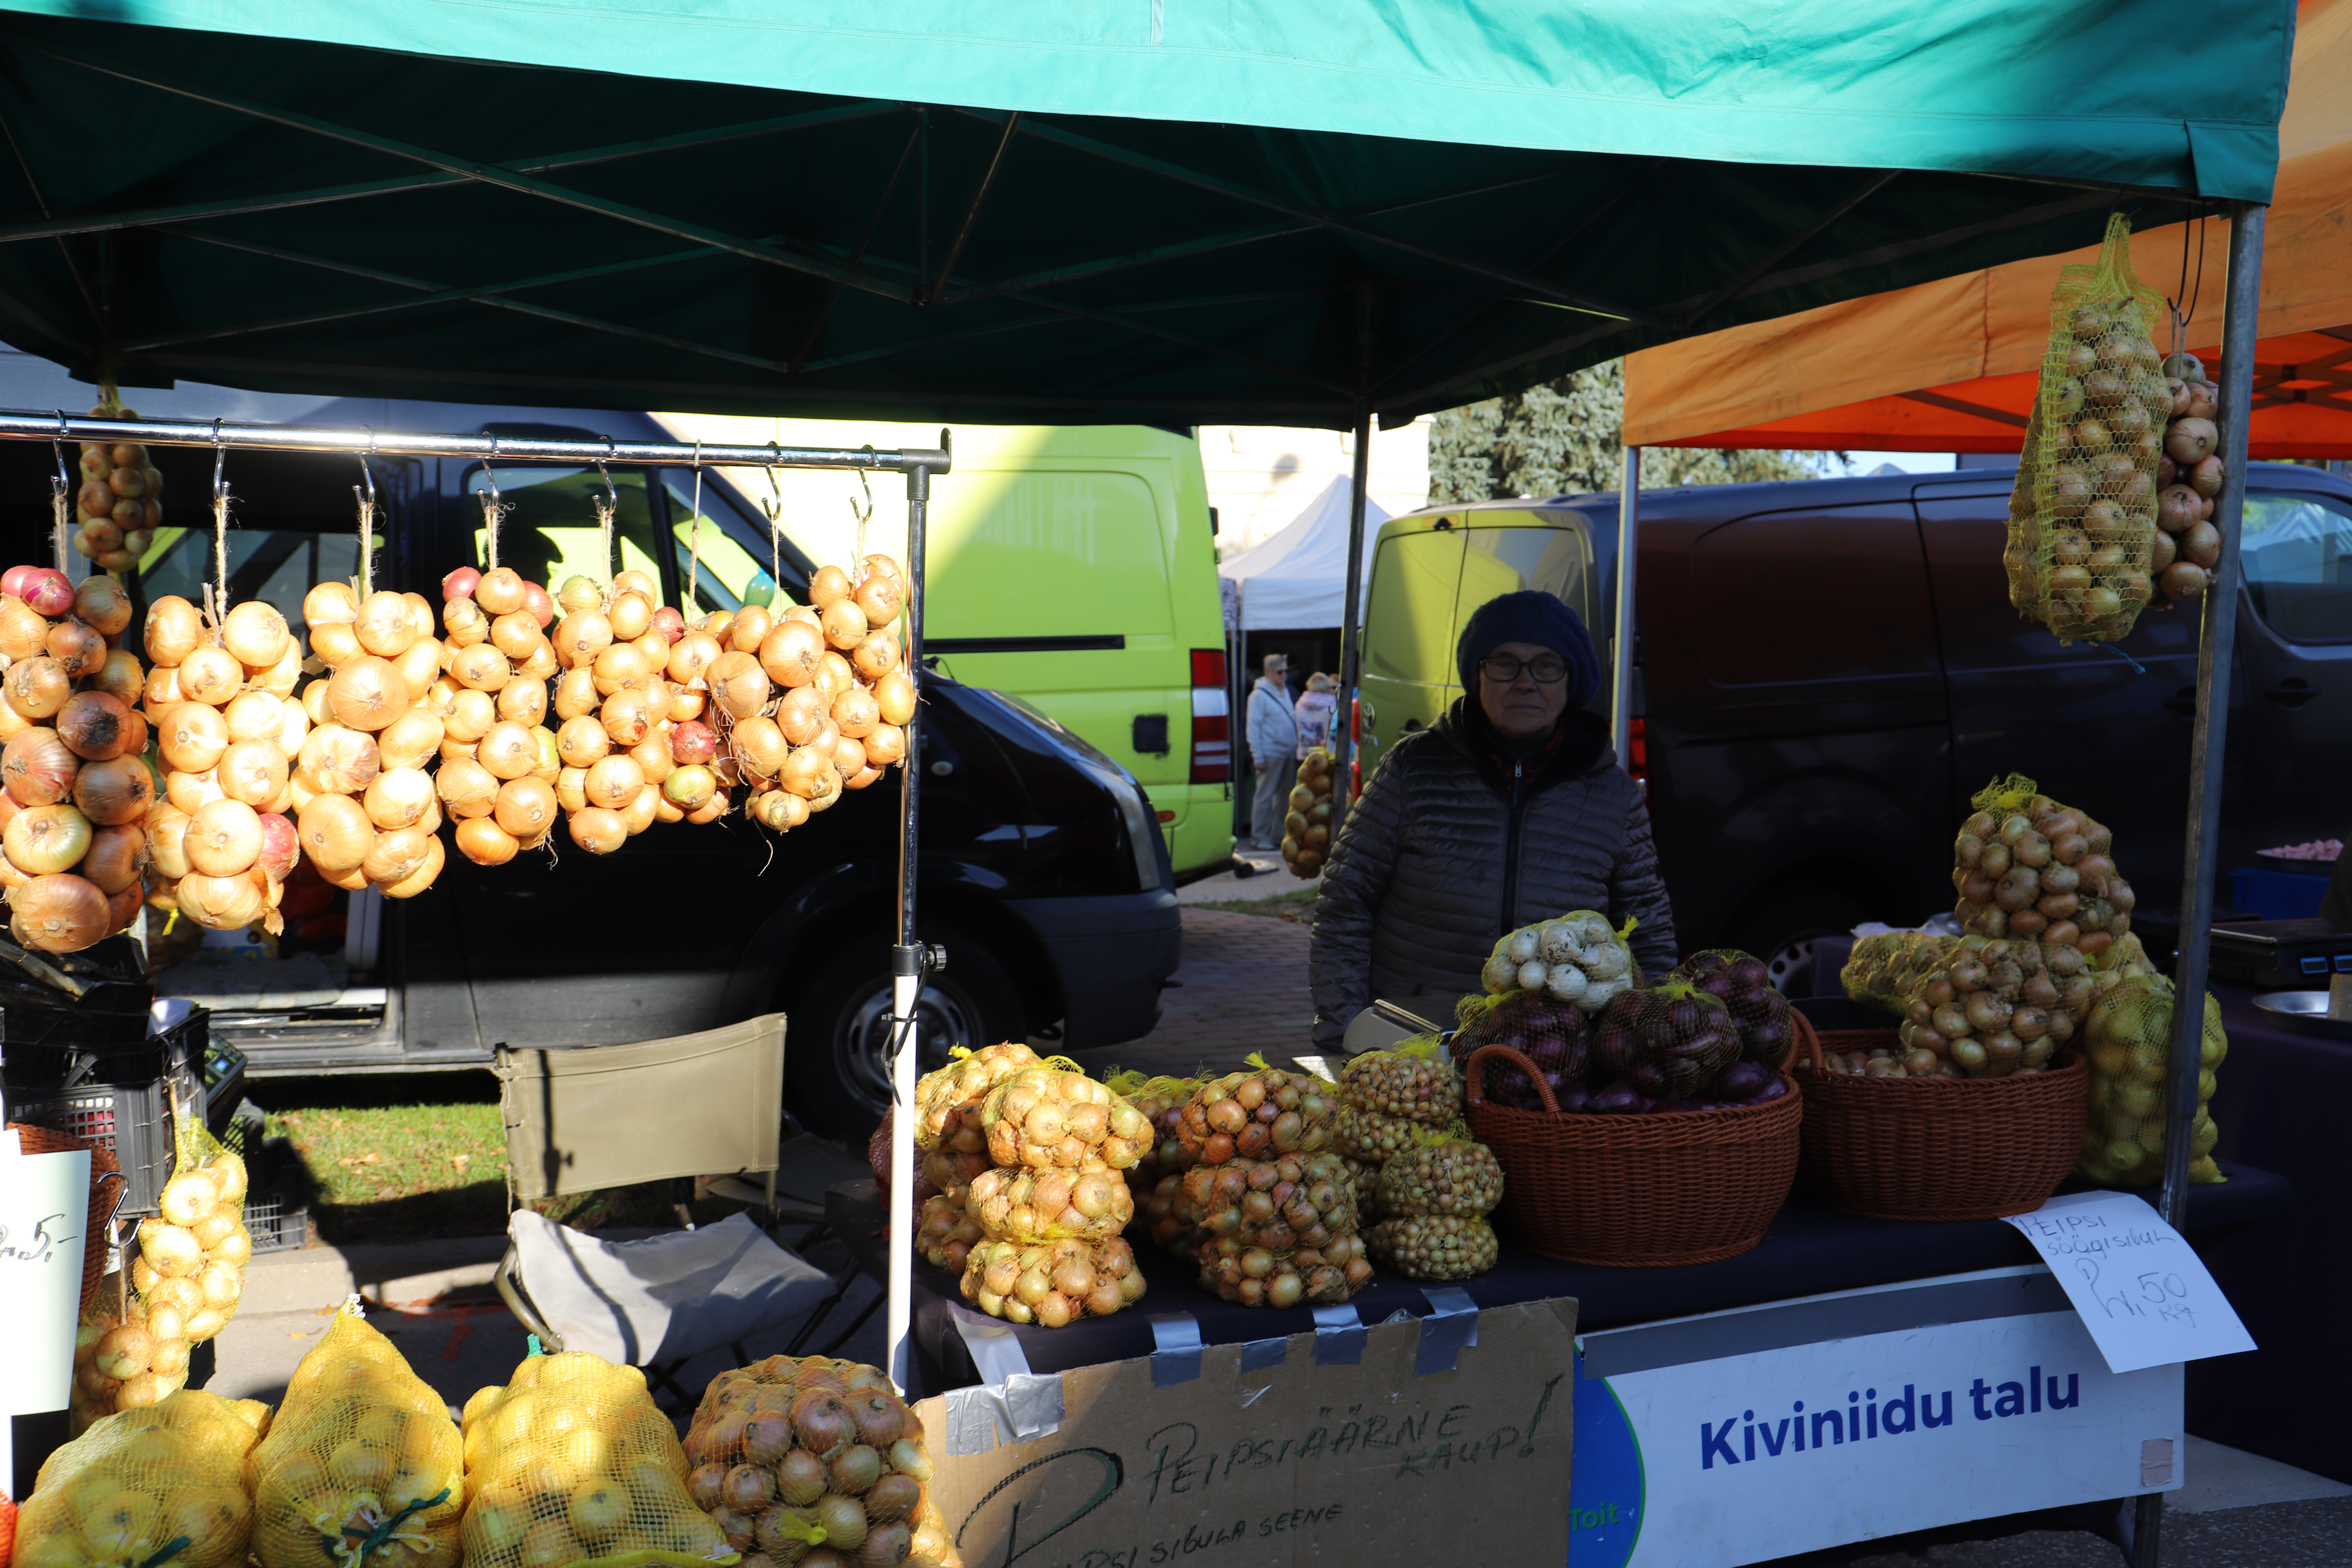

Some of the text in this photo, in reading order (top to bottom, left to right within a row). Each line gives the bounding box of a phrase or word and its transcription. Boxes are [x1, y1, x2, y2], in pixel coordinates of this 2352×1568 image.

[2011, 1215, 2106, 1237] PEIPSI
[1700, 1366, 2079, 1470] Kiviniidu talu
[1569, 1501, 1619, 1531] Toit
